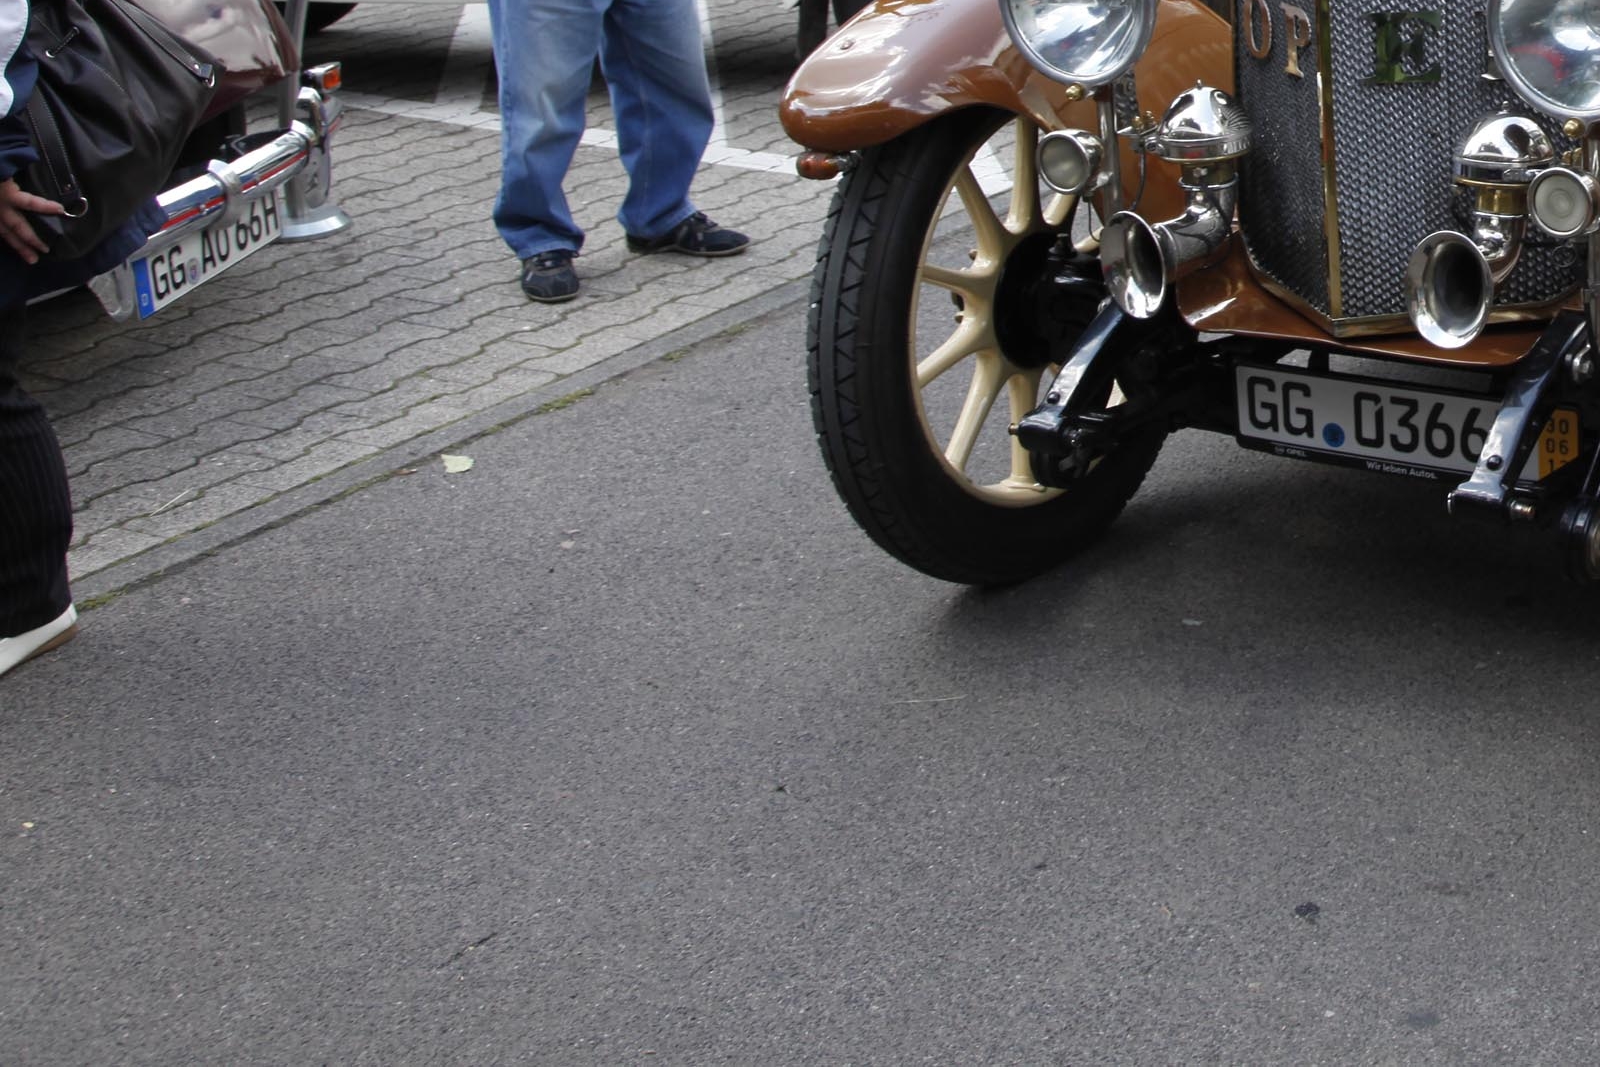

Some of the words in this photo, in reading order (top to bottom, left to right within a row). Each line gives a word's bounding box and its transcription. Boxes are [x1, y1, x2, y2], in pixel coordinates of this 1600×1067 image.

[151, 245, 187, 301] GG
[236, 191, 279, 250] 66H
[1247, 375, 1315, 439] GG
[1546, 437, 1569, 455] 06
[1366, 460, 1381, 471] Wir
[1383, 462, 1407, 476] leben
[1409, 467, 1438, 480] Autos.
